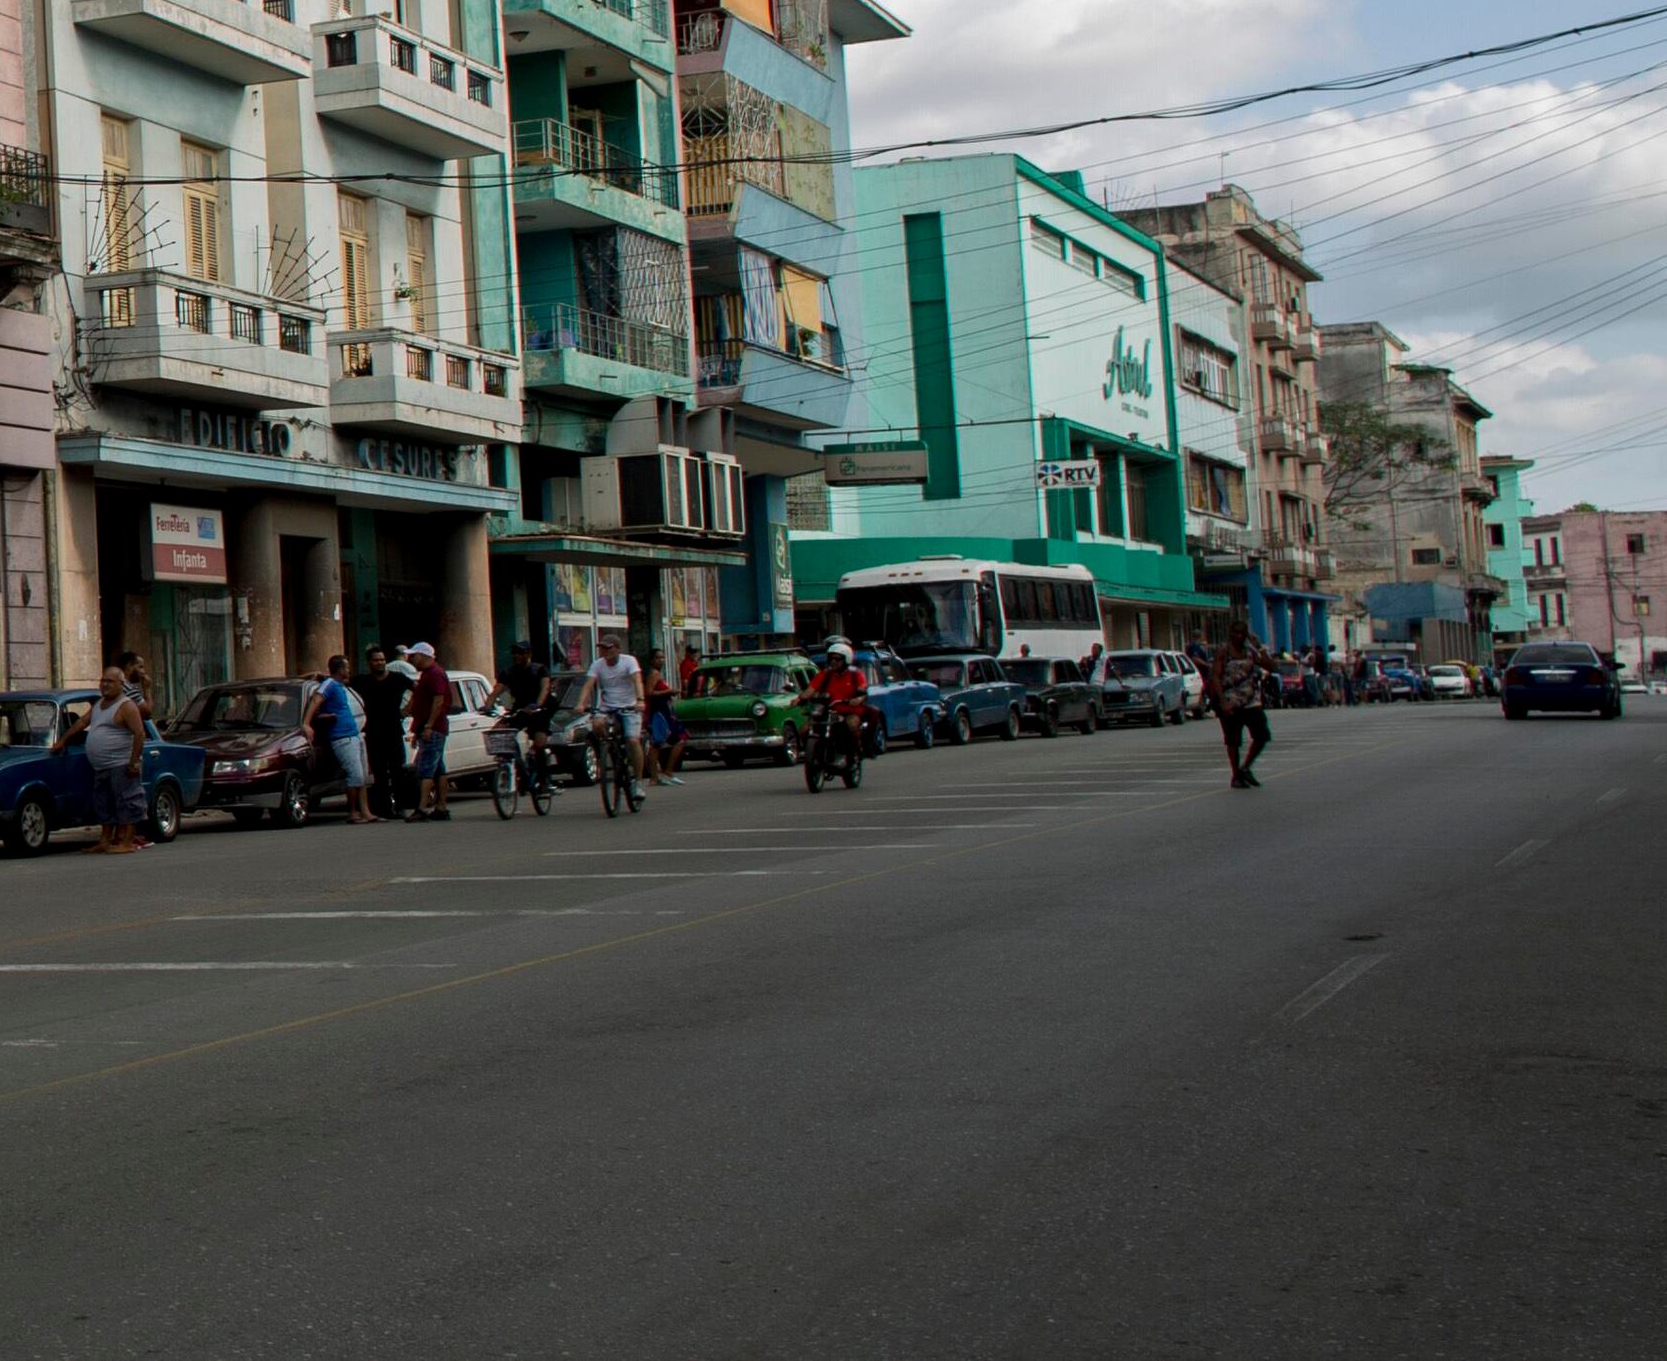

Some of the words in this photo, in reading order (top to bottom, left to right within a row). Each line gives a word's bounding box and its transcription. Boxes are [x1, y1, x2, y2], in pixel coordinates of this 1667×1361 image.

[181, 408, 293, 458] EDIFICIO
[357, 437, 457, 481] CESURES
[1065, 466, 1095, 481] RTV
[172, 549, 207, 572] Infanta
